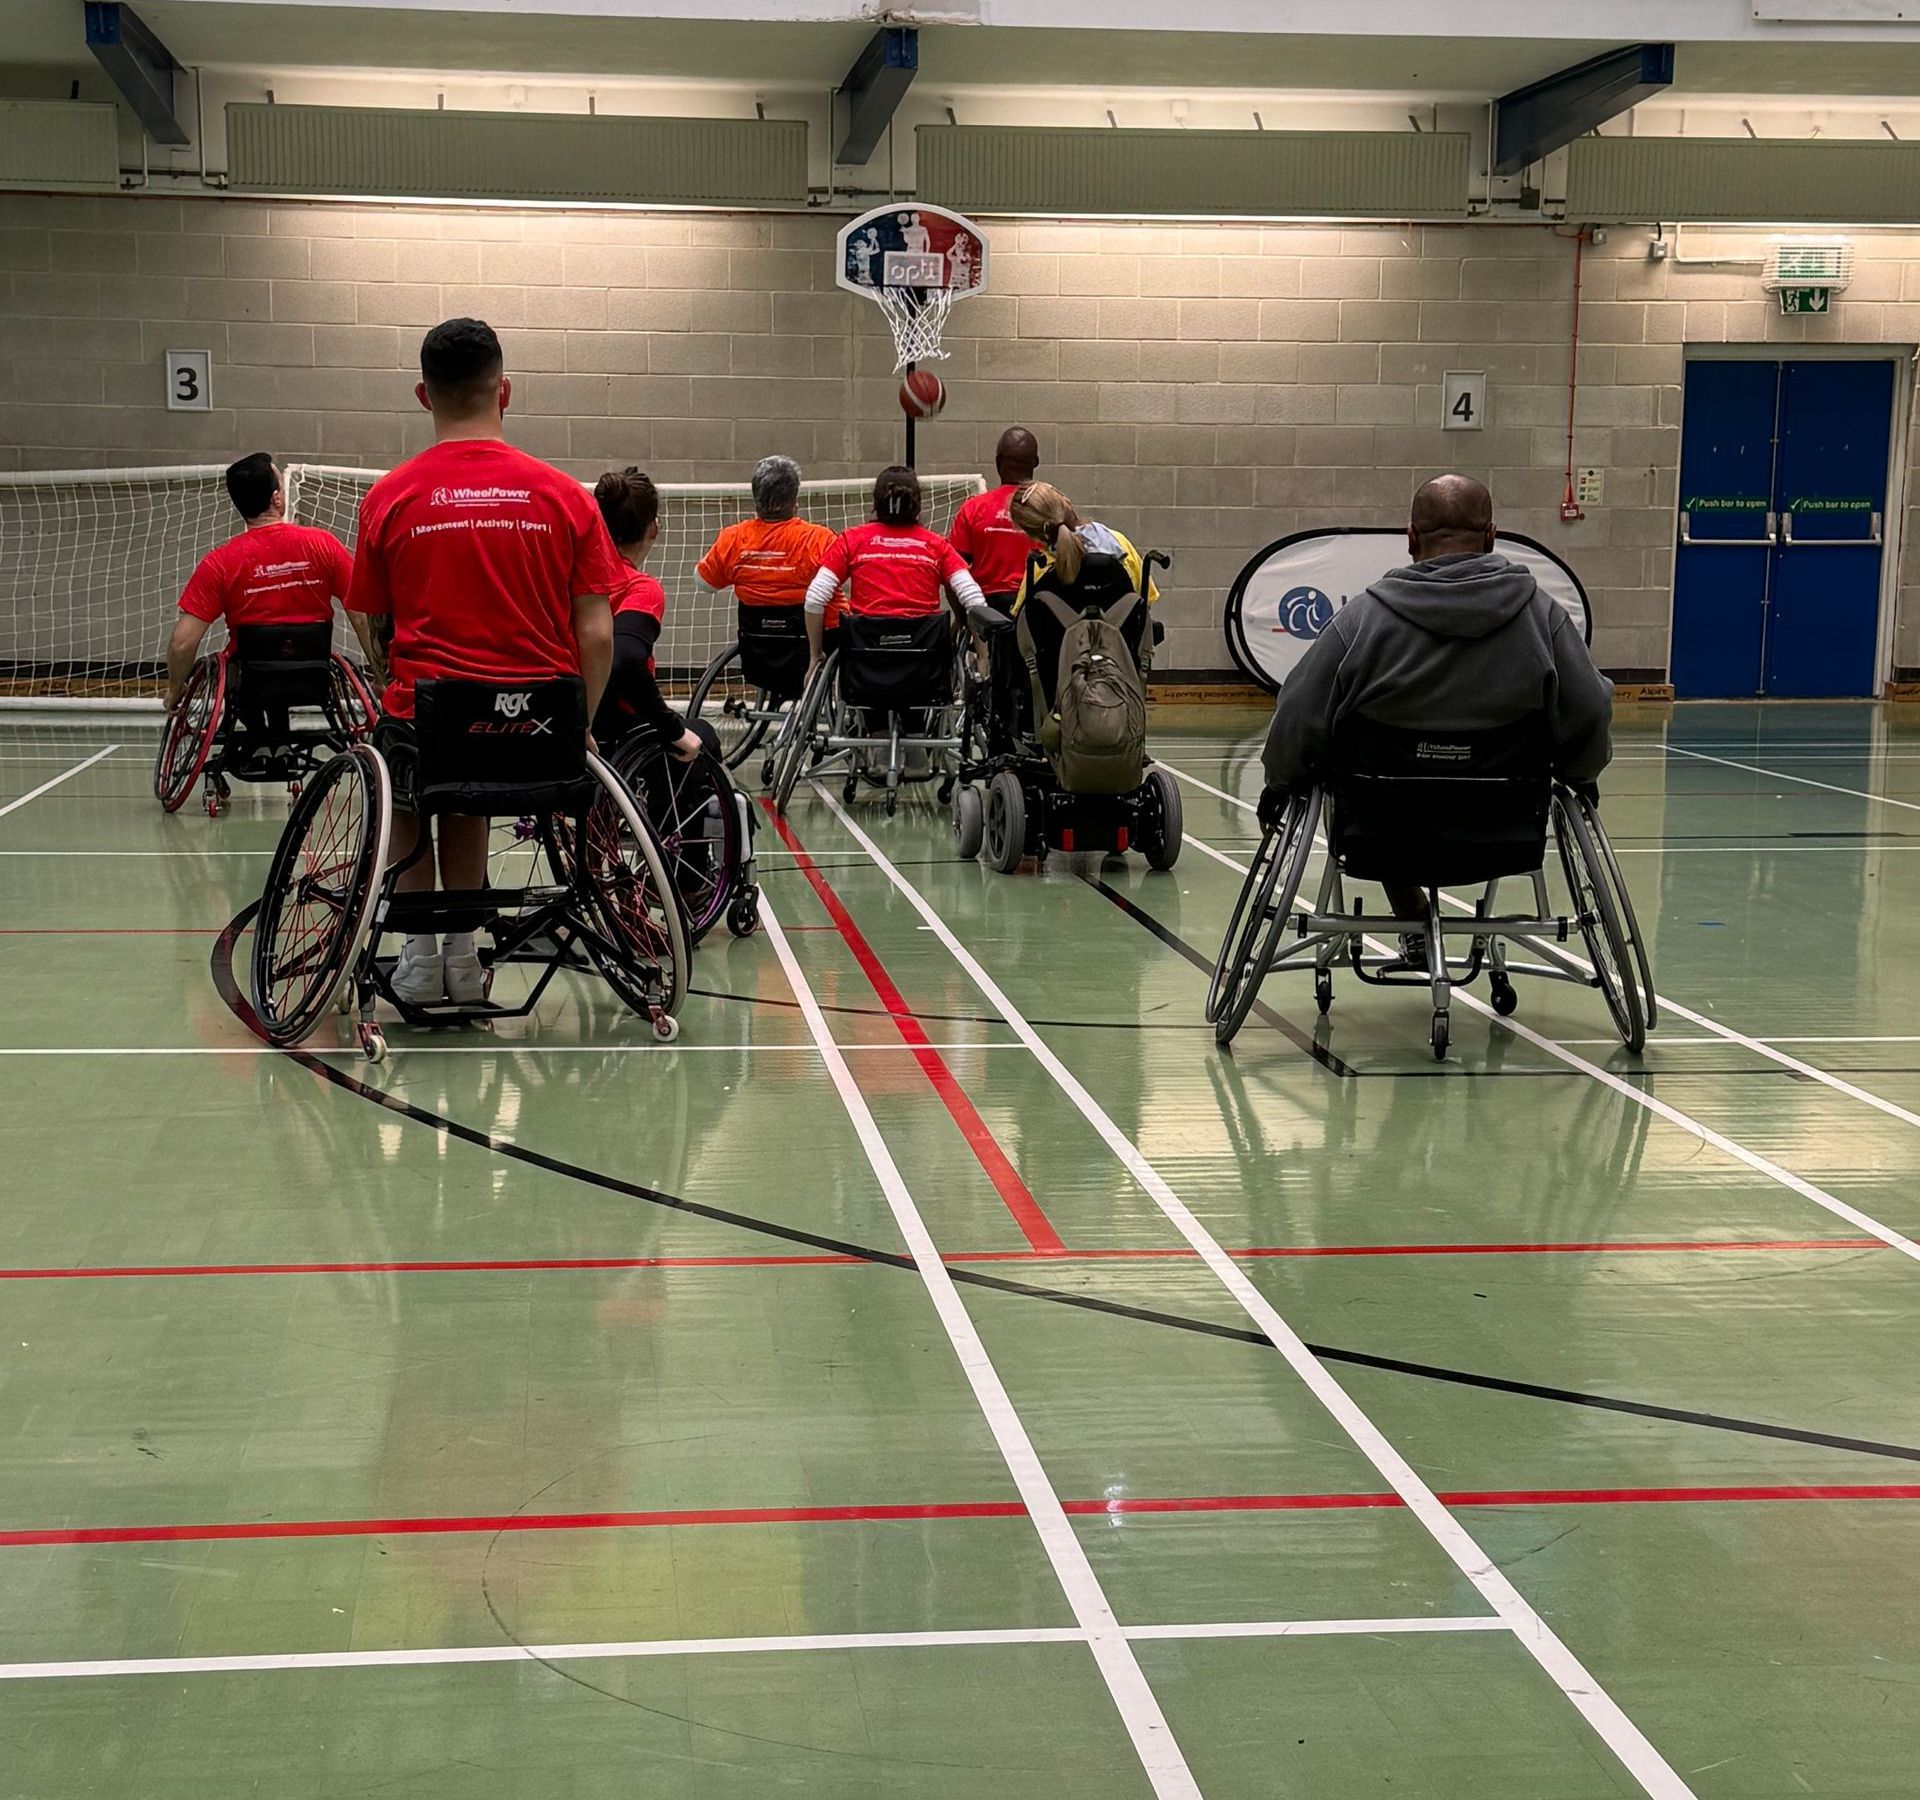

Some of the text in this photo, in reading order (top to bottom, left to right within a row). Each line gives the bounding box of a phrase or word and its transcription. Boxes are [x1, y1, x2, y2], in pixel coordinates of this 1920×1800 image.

[891, 259, 936, 285] opti
[176, 367, 199, 401] 3
[1452, 392, 1474, 422] 4
[453, 487, 531, 499] WheelPower
[1699, 499, 1767, 509] Push bar to open
[1803, 501, 1871, 511] Push bar to open
[416, 519, 547, 535] Movement Activity Sport
